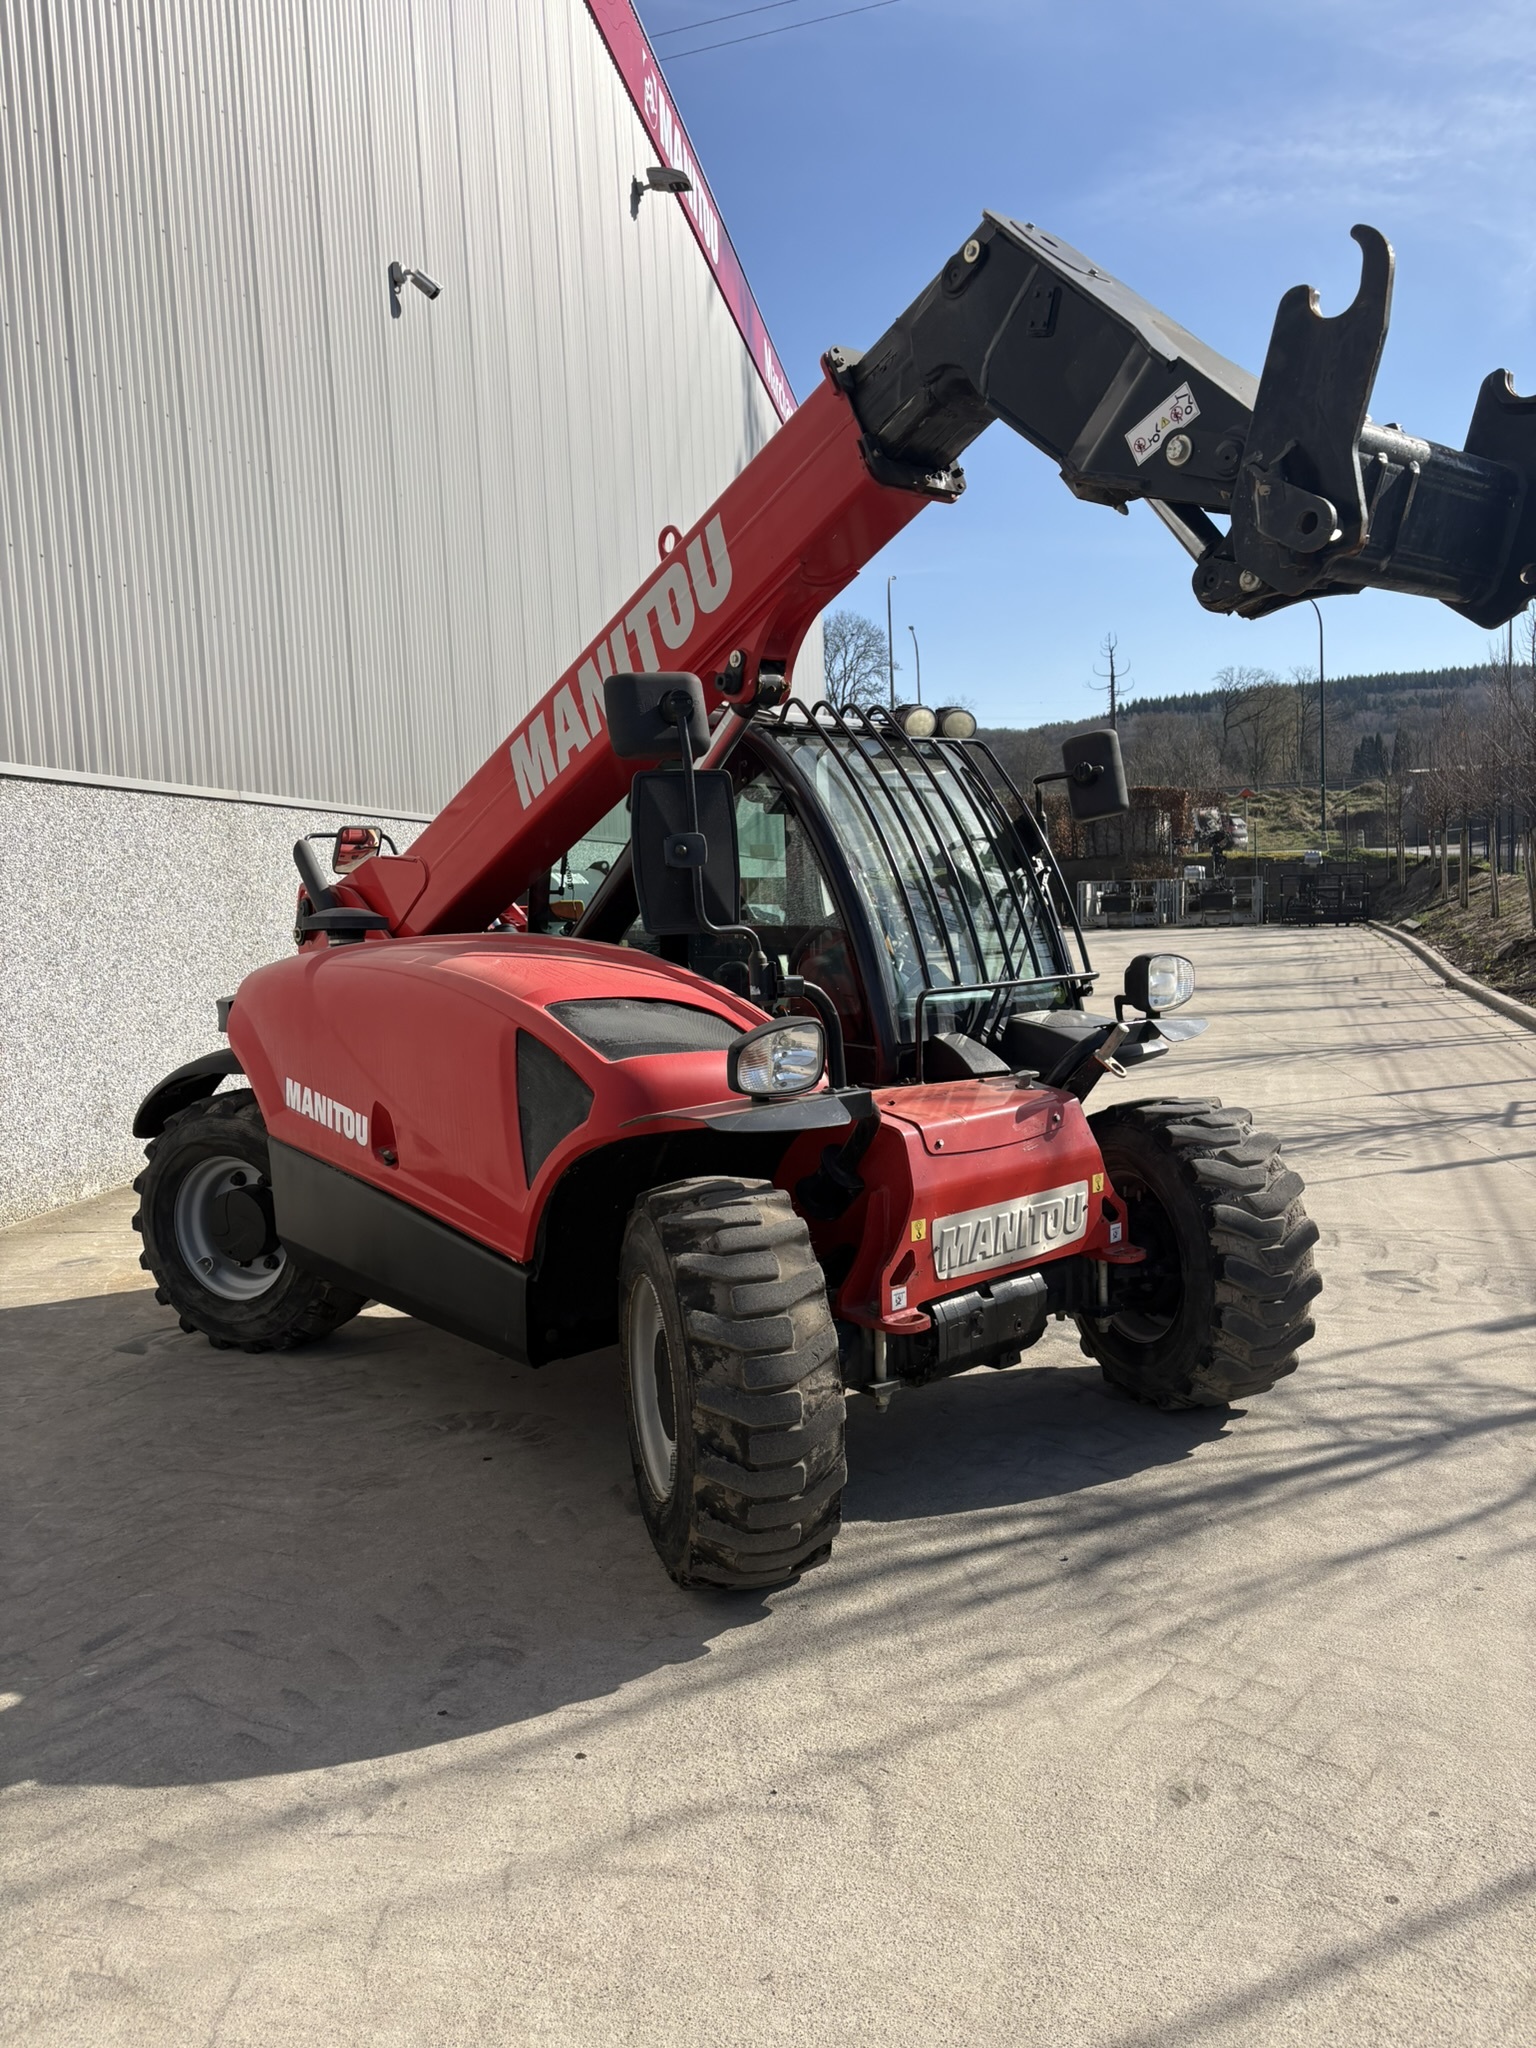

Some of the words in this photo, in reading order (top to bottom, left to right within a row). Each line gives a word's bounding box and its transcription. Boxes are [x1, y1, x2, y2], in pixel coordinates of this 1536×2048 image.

[658, 86, 719, 265] MANITOU
[509, 512, 732, 811] MANITOU
[285, 1076, 369, 1147] MANITOU
[938, 1191, 1086, 1273] MANITOU
